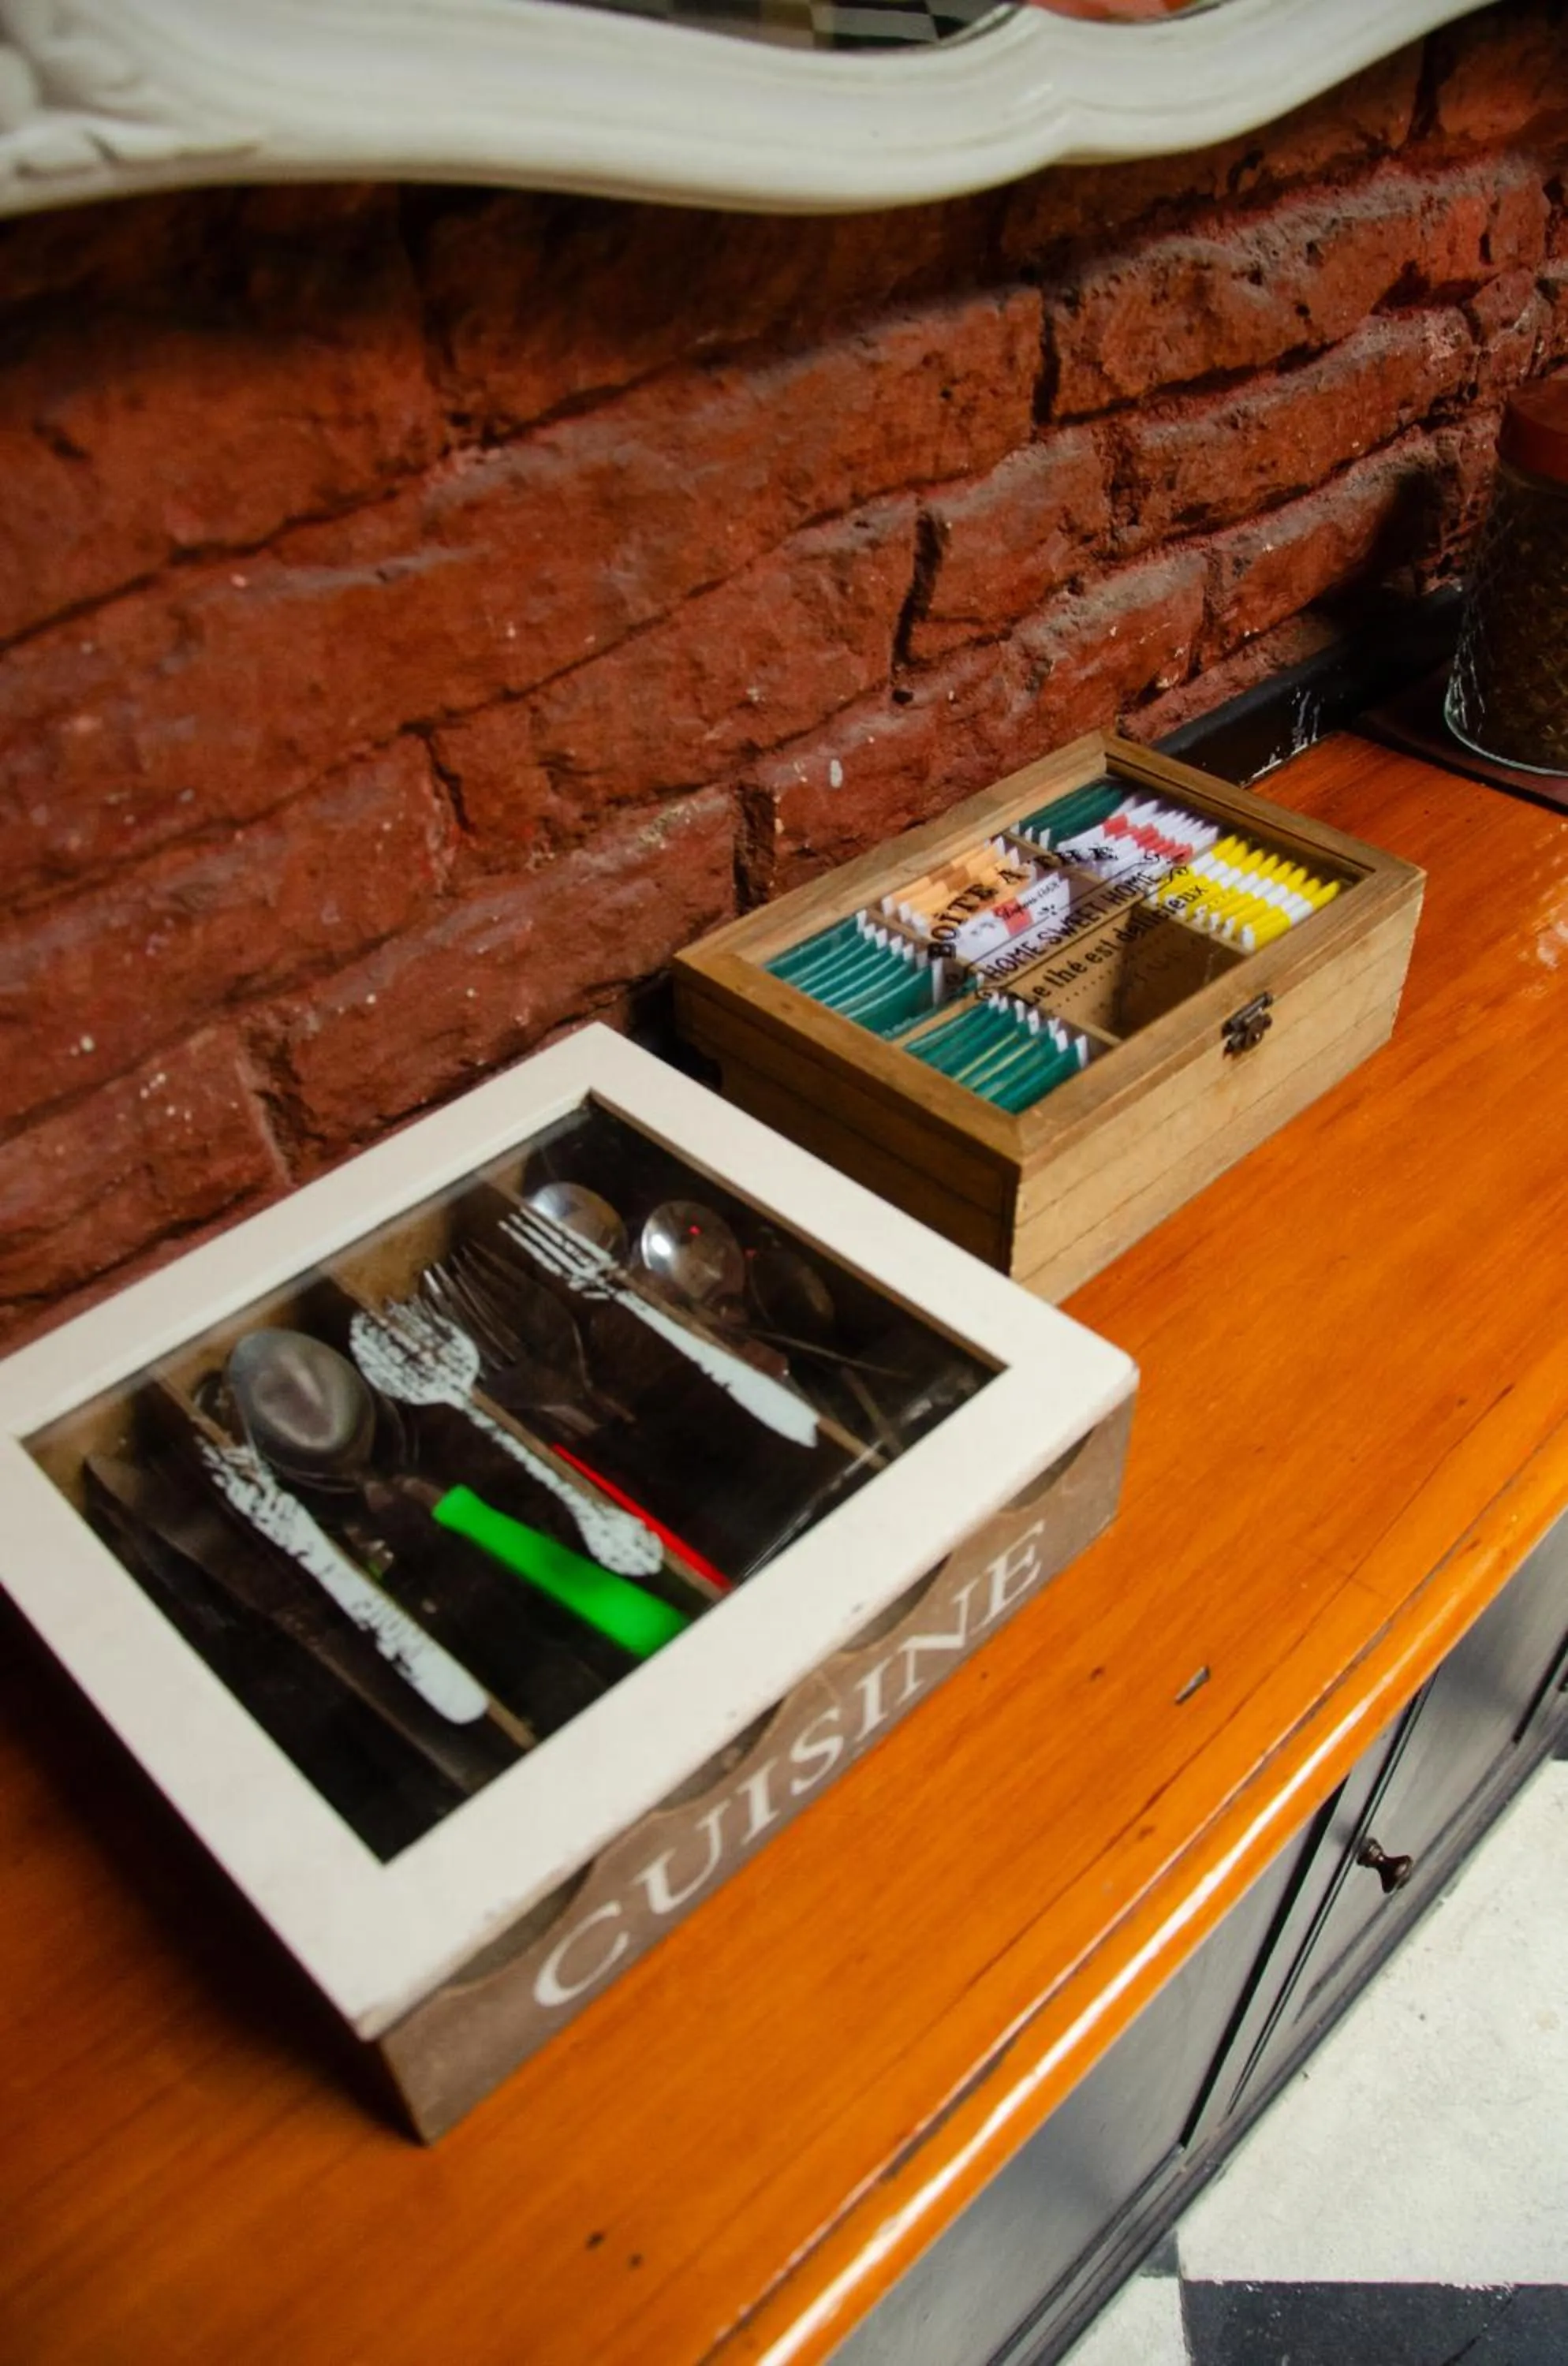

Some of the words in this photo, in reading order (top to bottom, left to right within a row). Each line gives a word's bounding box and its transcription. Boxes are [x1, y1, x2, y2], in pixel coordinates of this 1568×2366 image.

[981, 940, 1047, 981] HOME
[1037, 903, 1108, 945] SWEET
[1101, 871, 1162, 906] HOME
[1085, 939, 1120, 964] est
[533, 1521, 1045, 2007] CUISINE
